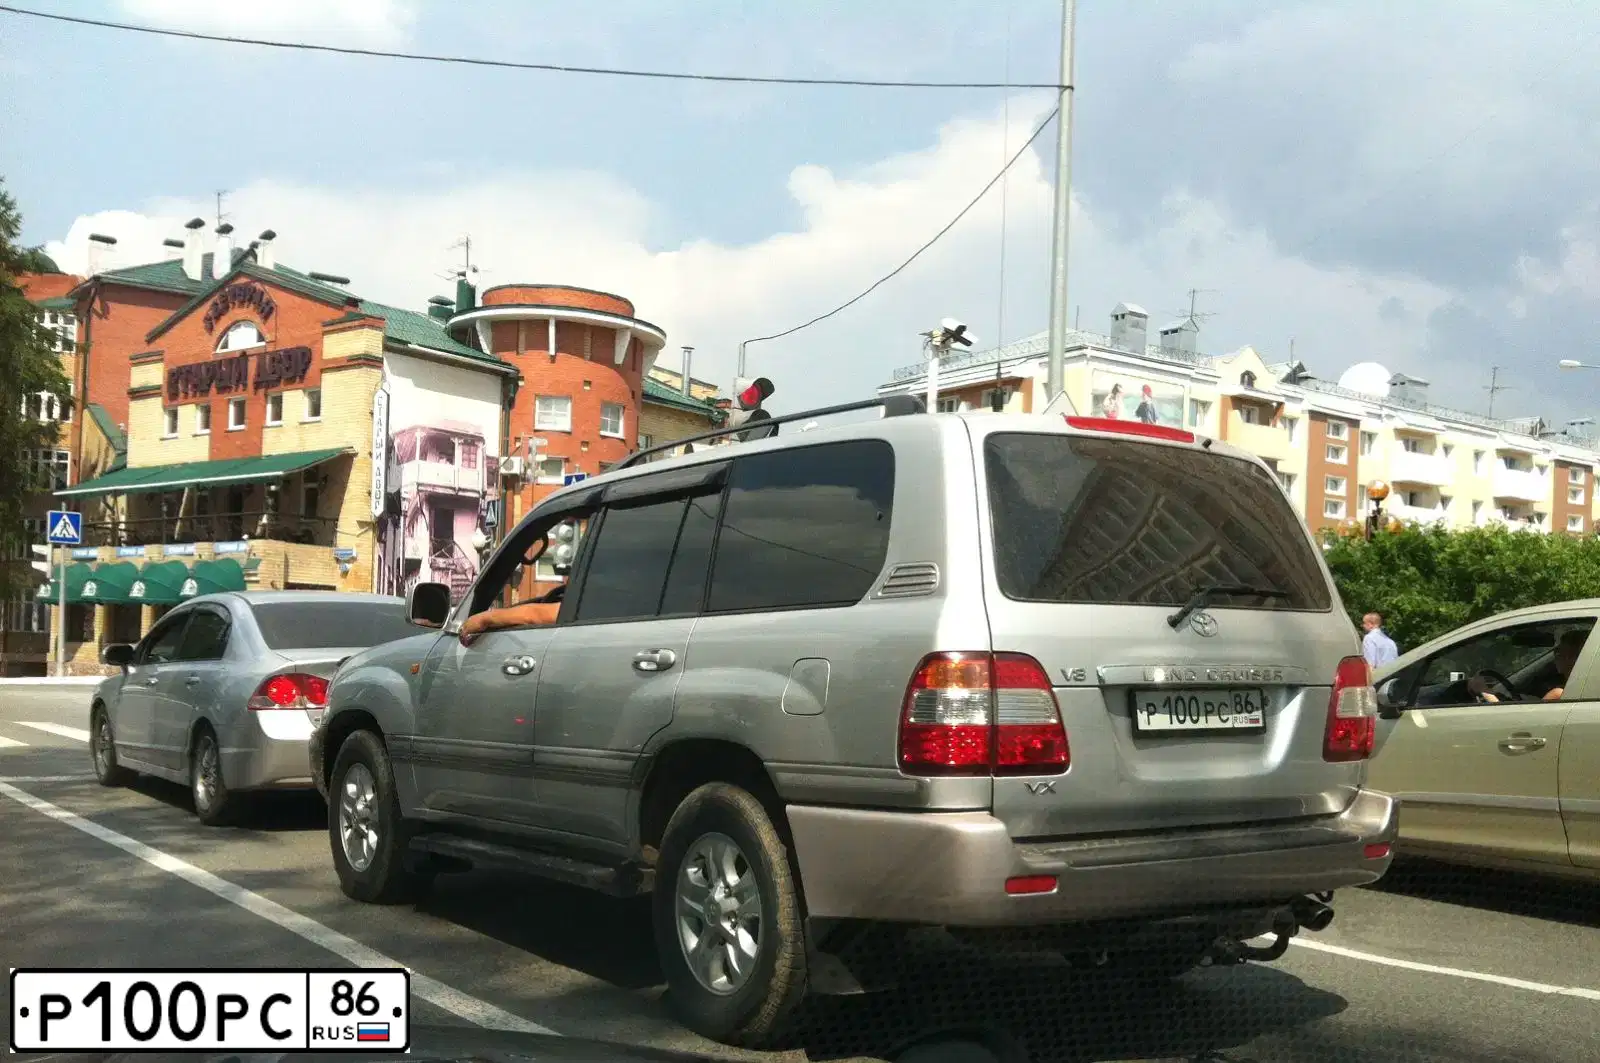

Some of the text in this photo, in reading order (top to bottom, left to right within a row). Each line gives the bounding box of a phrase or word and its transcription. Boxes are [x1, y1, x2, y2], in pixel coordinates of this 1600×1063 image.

[1060, 668, 1086, 682] V8
[1143, 668, 1283, 681] LND CRUISER
[1233, 692, 1255, 714] 86
[1024, 781, 1057, 795] VX
